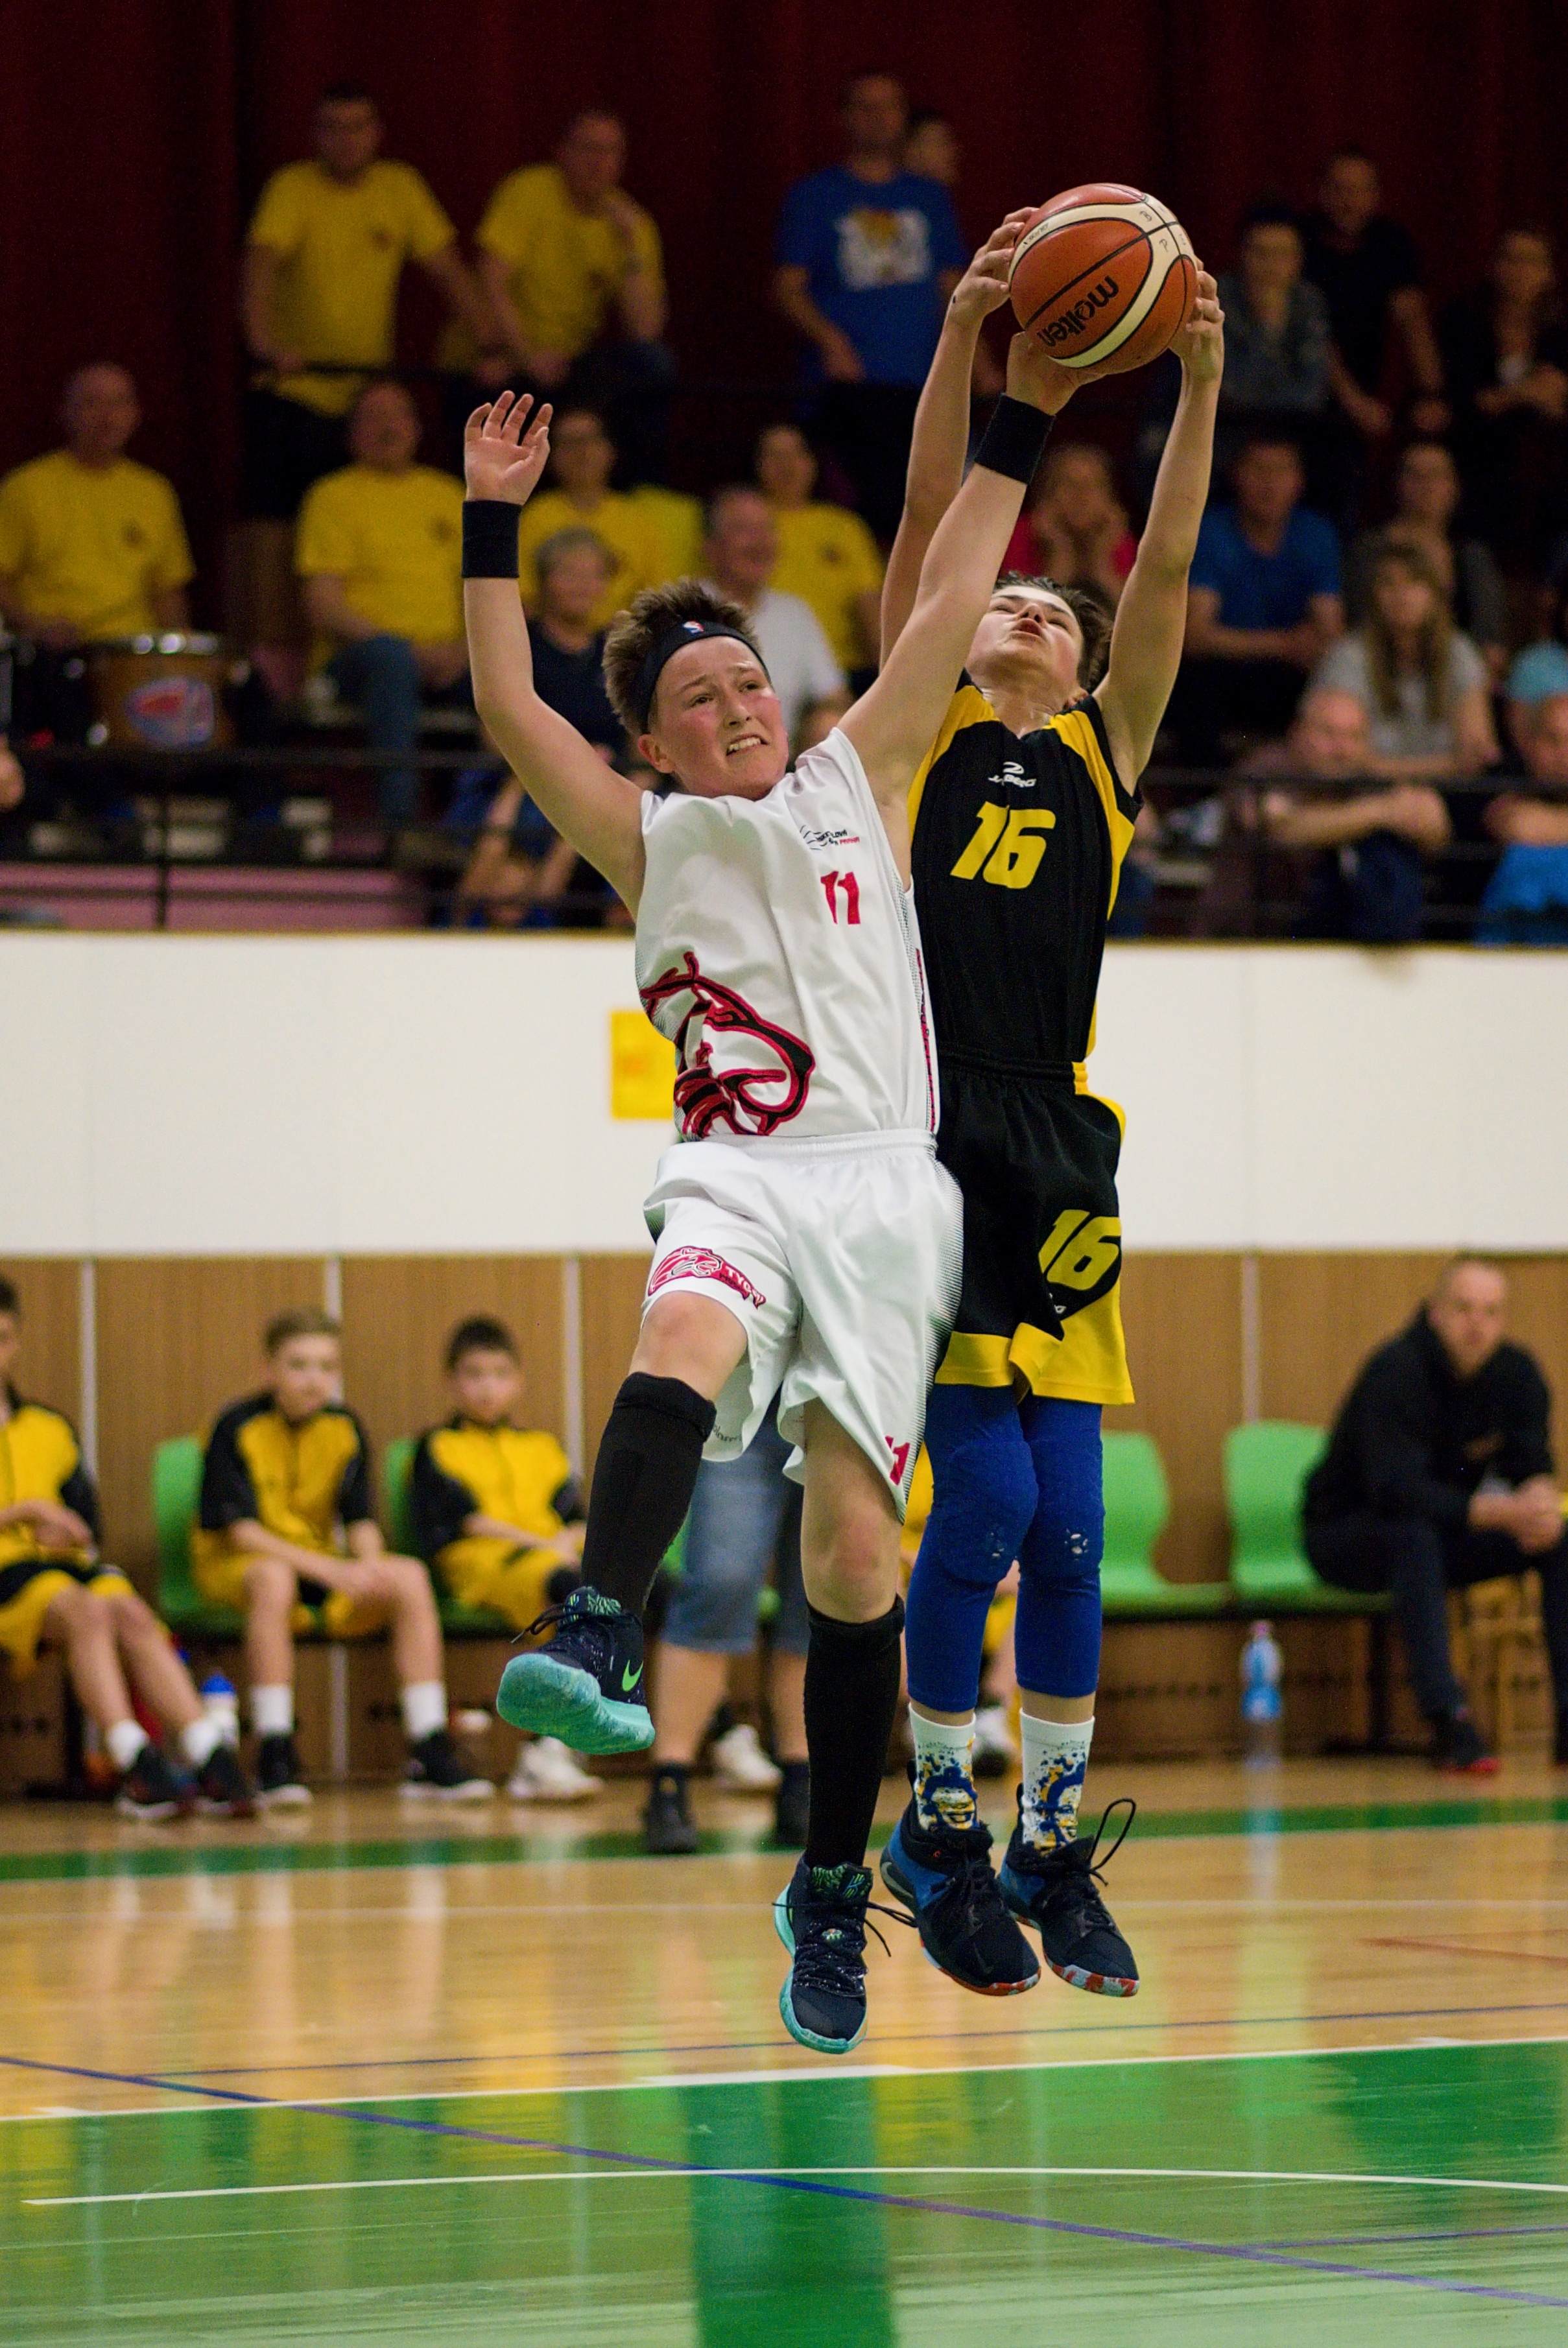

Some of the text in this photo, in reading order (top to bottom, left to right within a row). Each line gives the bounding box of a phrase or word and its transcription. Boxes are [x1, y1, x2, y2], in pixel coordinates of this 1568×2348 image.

[1037, 276, 1119, 347] molten
[950, 801, 1056, 889] 16
[820, 871, 861, 925] 11
[1039, 1209, 1121, 1290] 16
